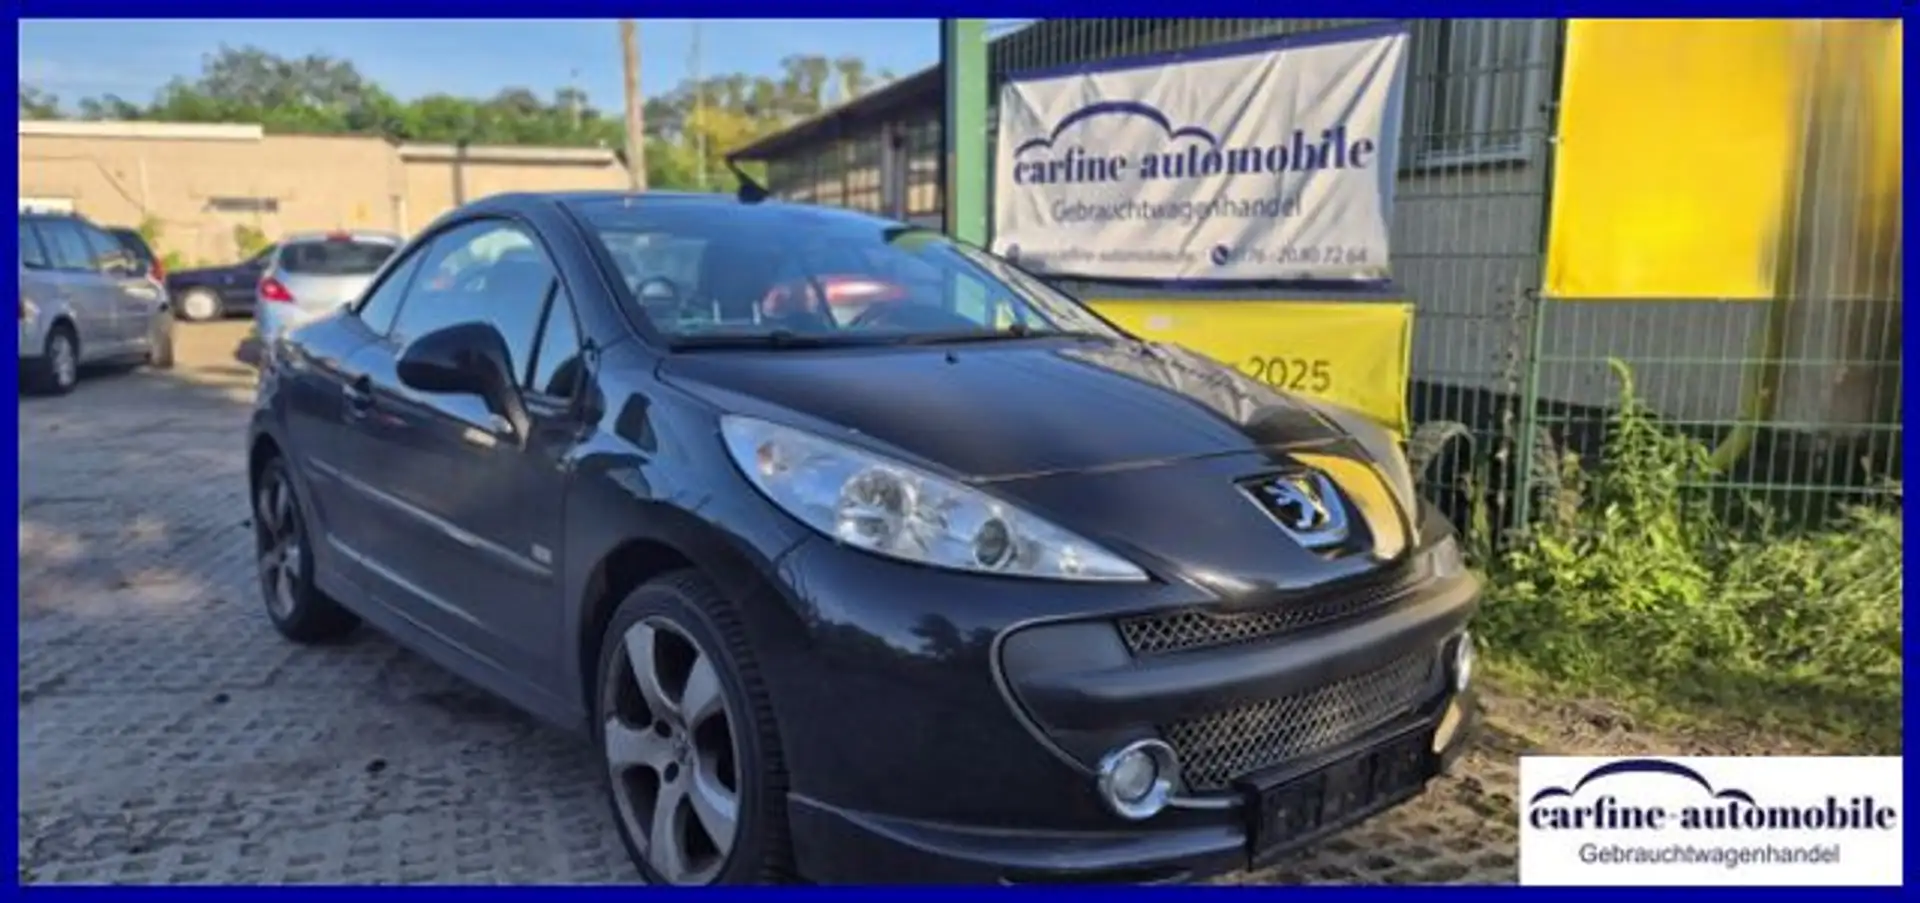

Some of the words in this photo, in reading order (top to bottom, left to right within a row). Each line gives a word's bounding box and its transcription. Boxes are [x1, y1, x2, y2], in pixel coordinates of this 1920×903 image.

[1050, 194, 1302, 225] Gebrauchtwagenhandel
[1323, 246, 1344, 264] 72
[1249, 355, 1331, 393] 2025
